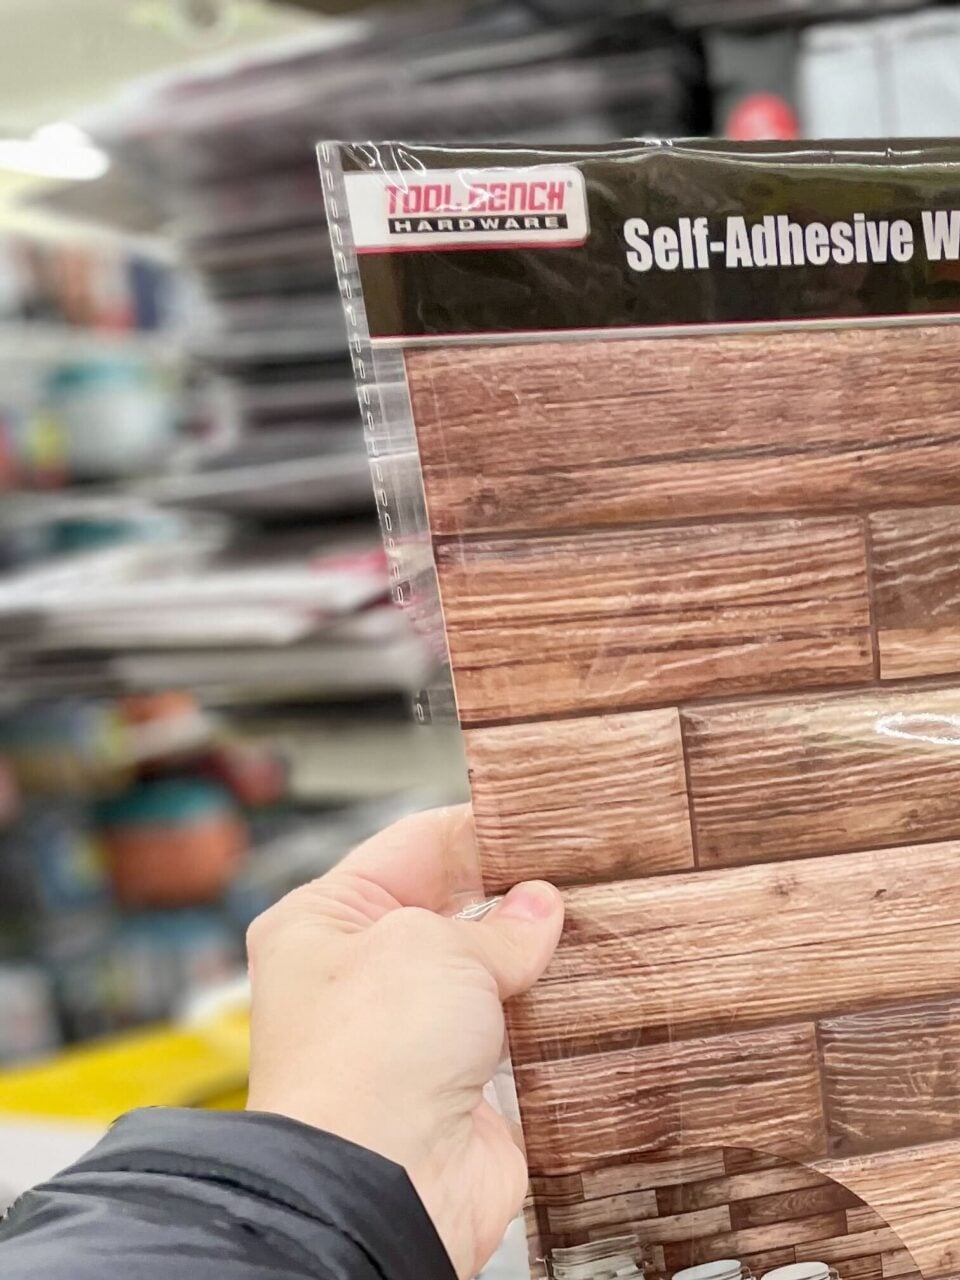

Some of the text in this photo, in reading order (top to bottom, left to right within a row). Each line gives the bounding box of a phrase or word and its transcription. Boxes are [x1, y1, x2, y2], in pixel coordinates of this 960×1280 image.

[385, 181, 566, 215] TOOL BENCH
[394, 216, 559, 233] HARDWARE
[623, 212, 914, 272] Self-Adhesive
